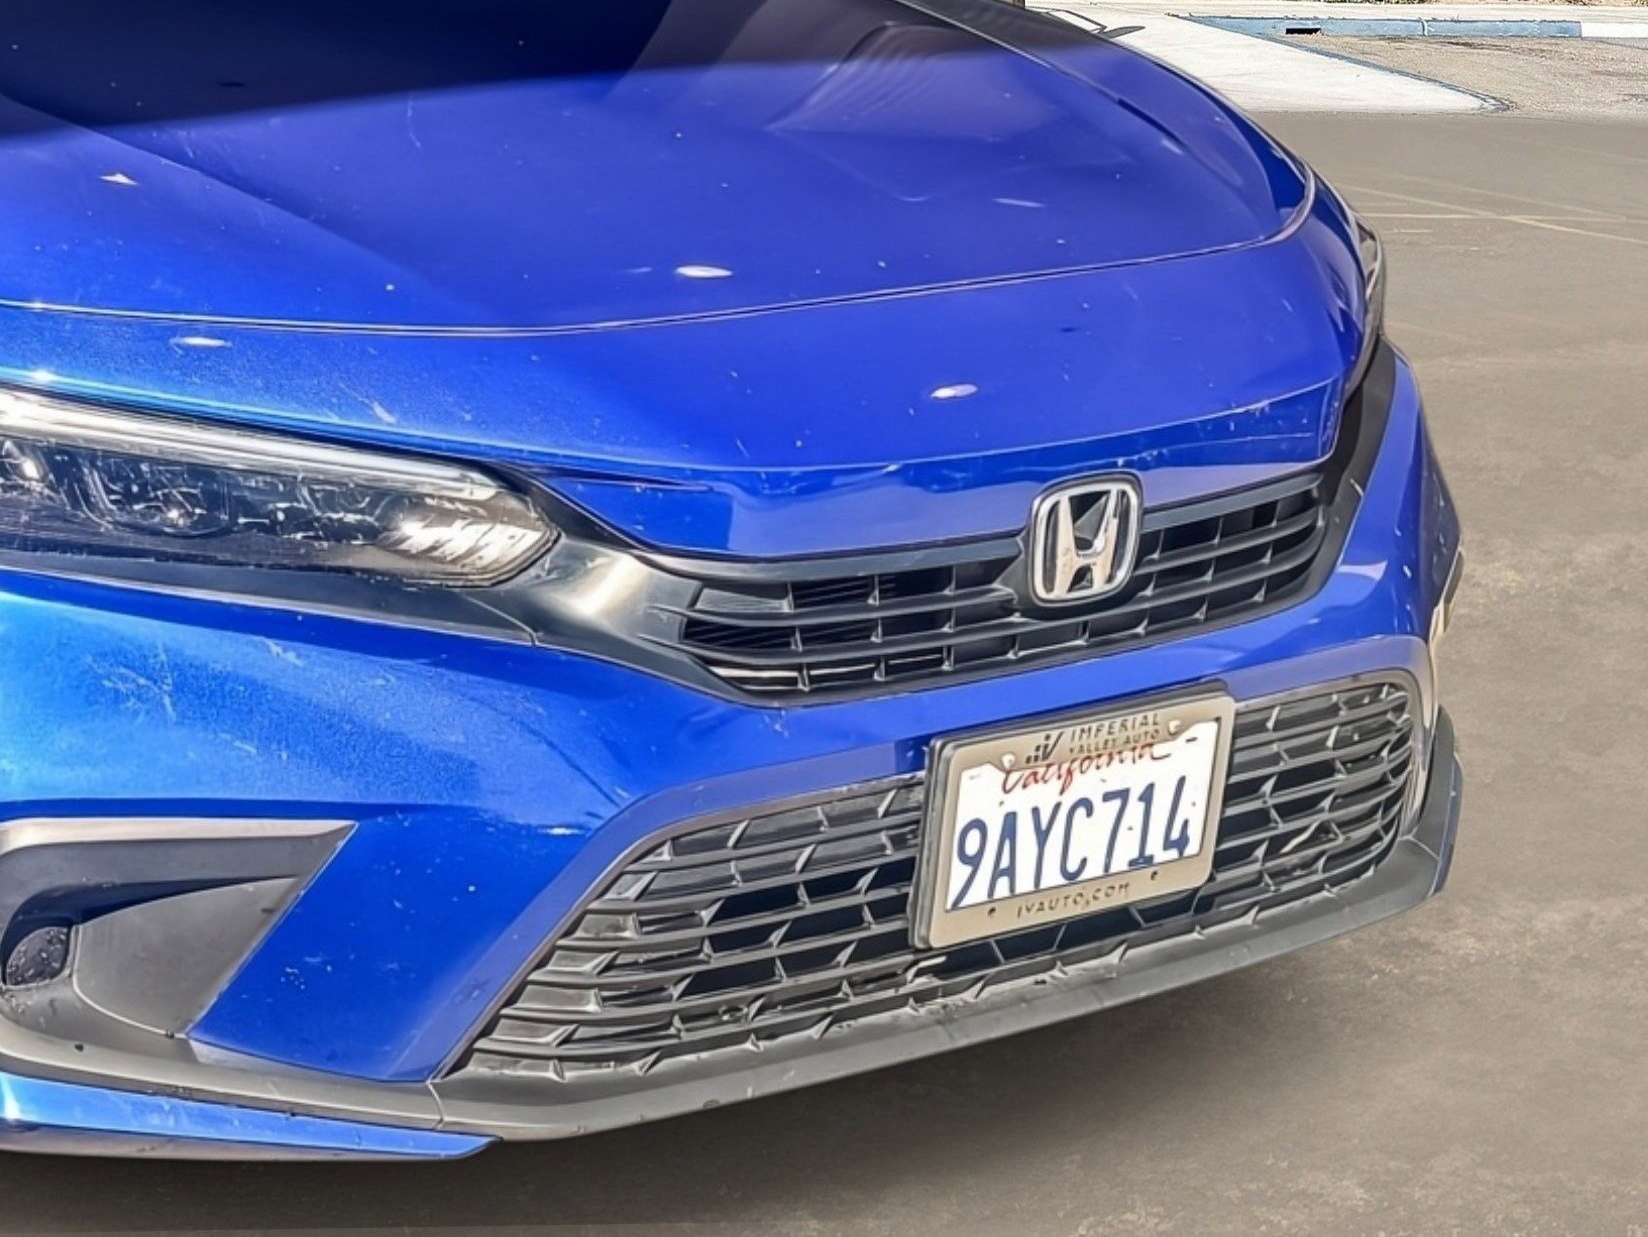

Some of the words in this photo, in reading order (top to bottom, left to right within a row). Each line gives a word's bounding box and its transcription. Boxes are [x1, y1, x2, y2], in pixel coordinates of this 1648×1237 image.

[1069, 737, 1118, 755] VALLEY
[1122, 729, 1160, 745] AUTO
[1070, 713, 1160, 743] IMPERIAL
[951, 775, 1190, 911] 9AYC714
